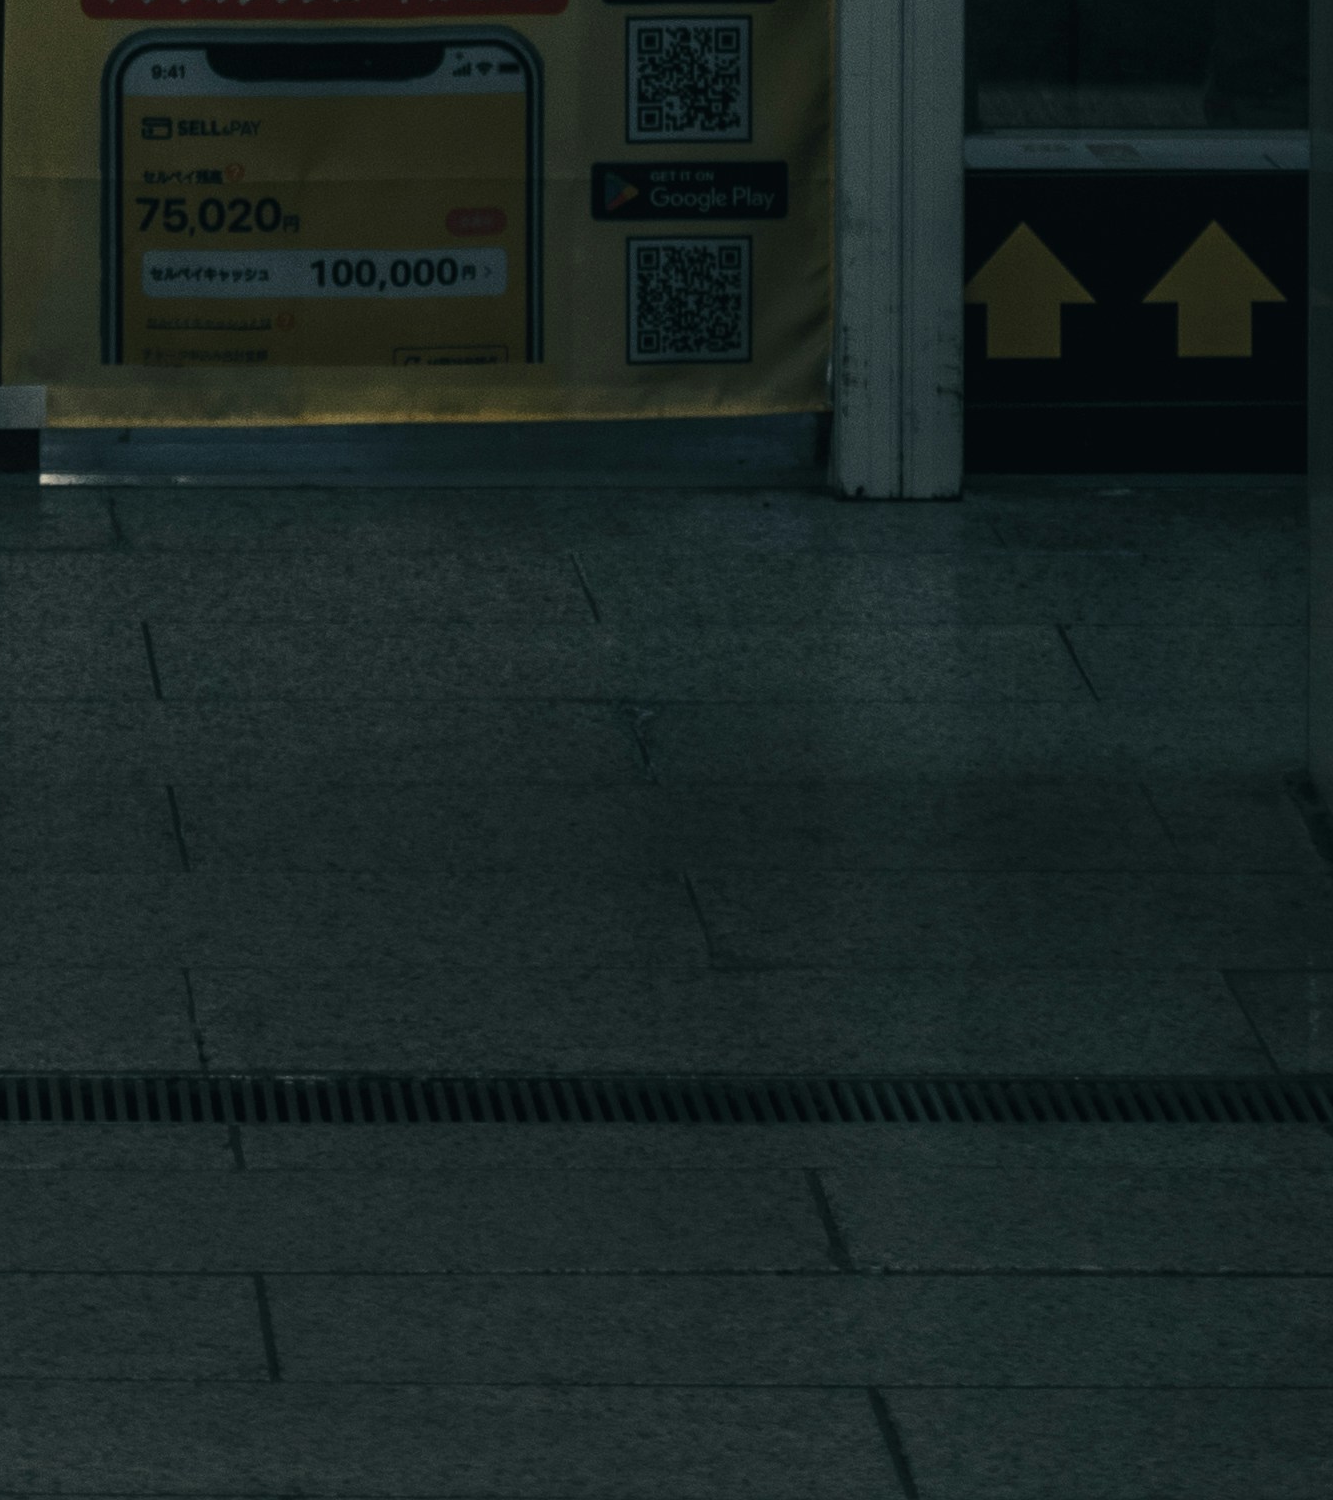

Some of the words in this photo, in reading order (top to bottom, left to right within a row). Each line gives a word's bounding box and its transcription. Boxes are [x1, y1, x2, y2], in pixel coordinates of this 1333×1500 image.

[151, 64, 186, 81] 9:41
[177, 119, 262, 138] SELL&PAY
[651, 171, 674, 181] GET
[649, 186, 727, 212] Google
[732, 186, 775, 211] Play
[135, 199, 300, 236] 75,020円
[309, 258, 477, 288] 100,000円
